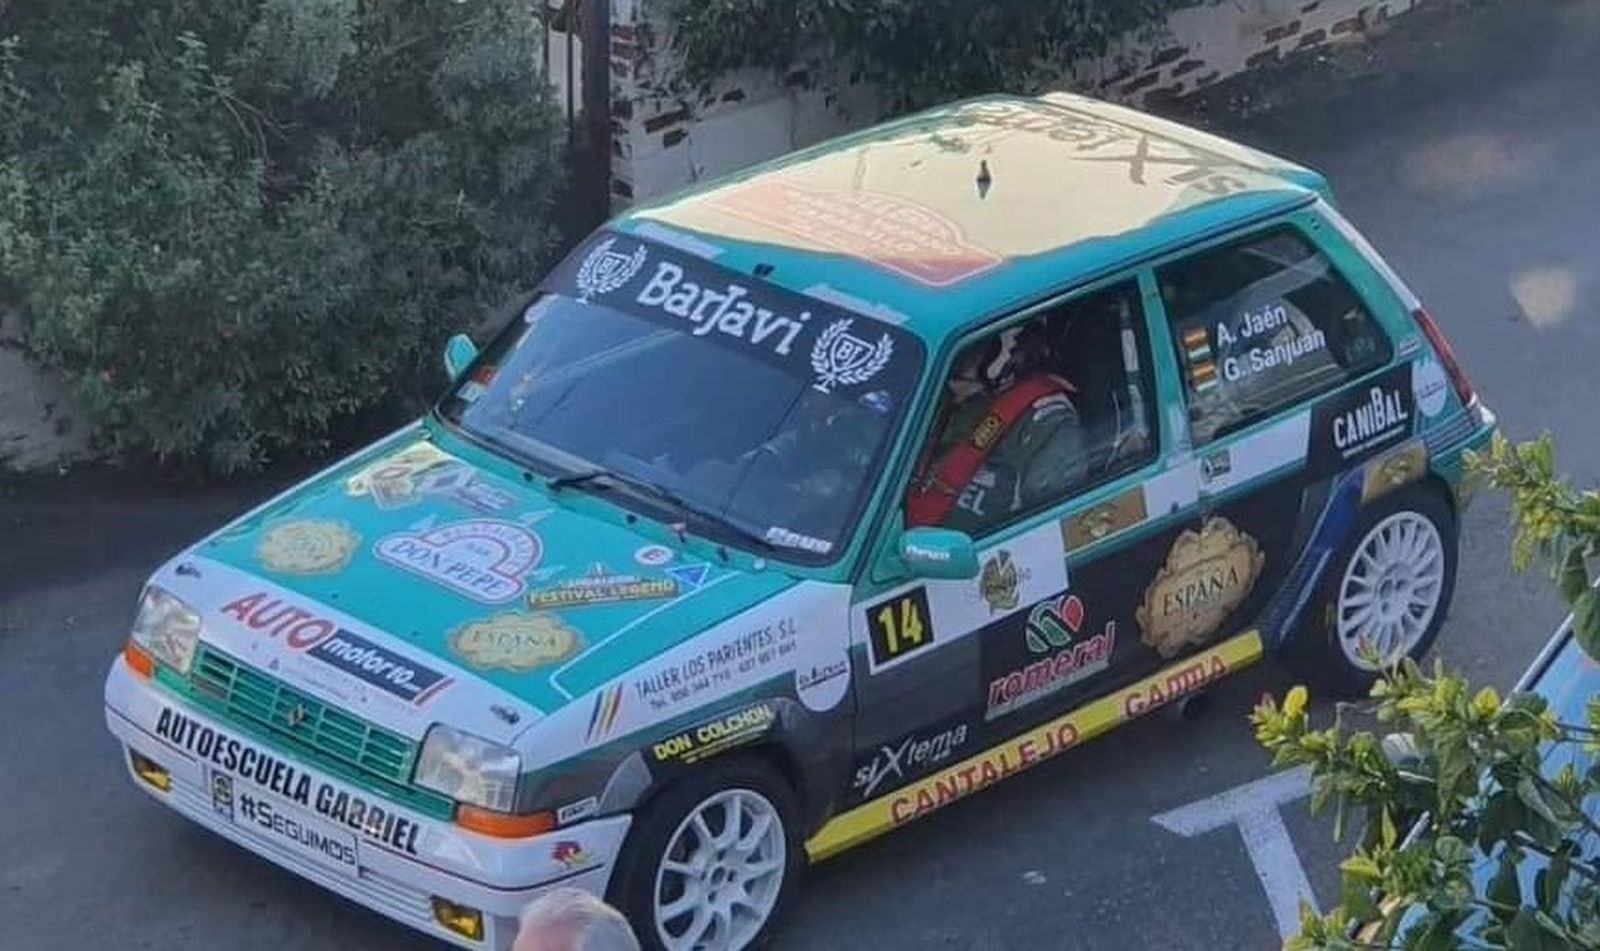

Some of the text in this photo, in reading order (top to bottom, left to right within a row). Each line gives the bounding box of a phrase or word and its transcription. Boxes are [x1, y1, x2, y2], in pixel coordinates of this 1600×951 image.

[637, 261, 812, 356] BarJavi
[1217, 304, 1287, 347] A. Jaén
[1224, 329, 1326, 381] G. Sanjuan
[219, 592, 335, 650] AUTO
[878, 598, 924, 654] 14
[634, 664, 682, 702] TALLER
[682, 654, 706, 681] LOS
[653, 732, 693, 761] DON
[890, 721, 1080, 825] CANTALEJO
[156, 706, 419, 855] AUTOESCUELA GABRIEL
